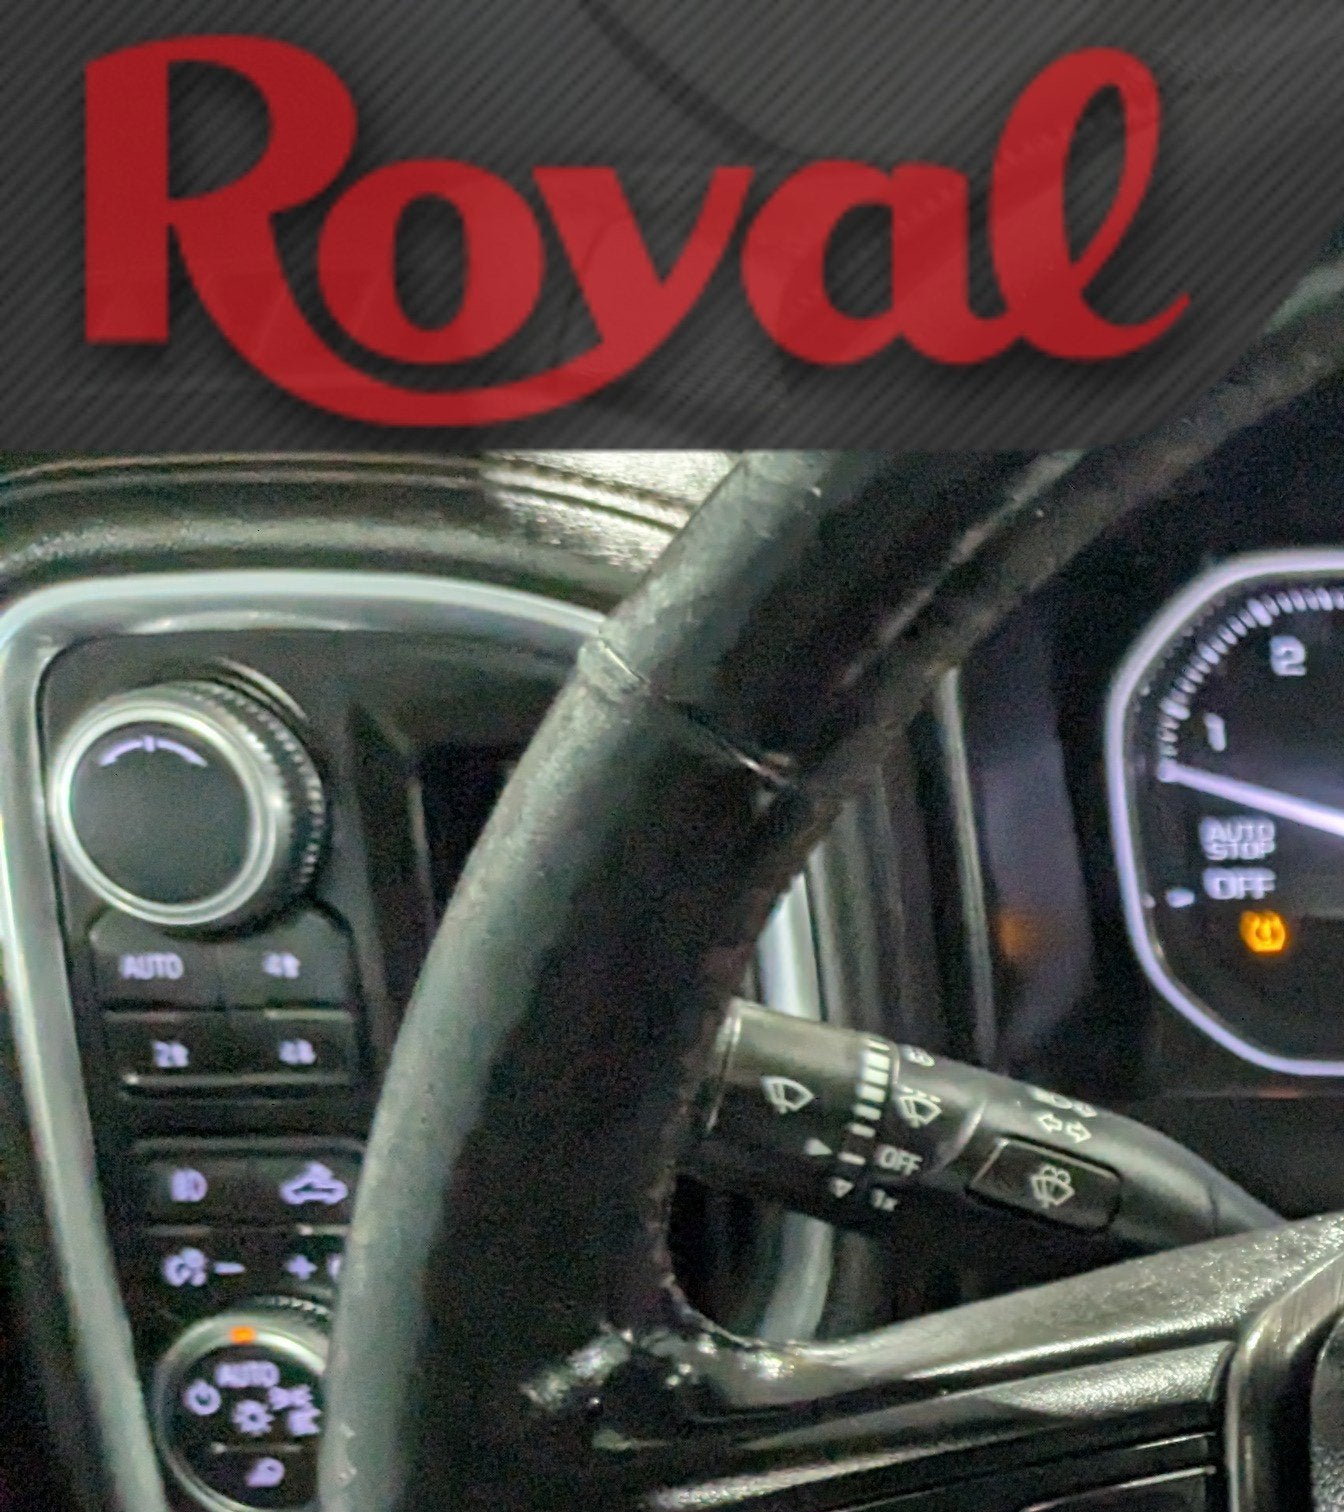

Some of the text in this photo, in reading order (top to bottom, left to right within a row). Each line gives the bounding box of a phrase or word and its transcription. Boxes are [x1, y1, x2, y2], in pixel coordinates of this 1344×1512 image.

[1270, 636, 1306, 676] 2
[1204, 714, 1227, 751] 1
[1199, 816, 1276, 843] AUTO
[1203, 840, 1276, 861] STOP
[1202, 866, 1277, 900] OFF
[119, 952, 185, 980] AUTO
[875, 1144, 923, 1176] OFF
